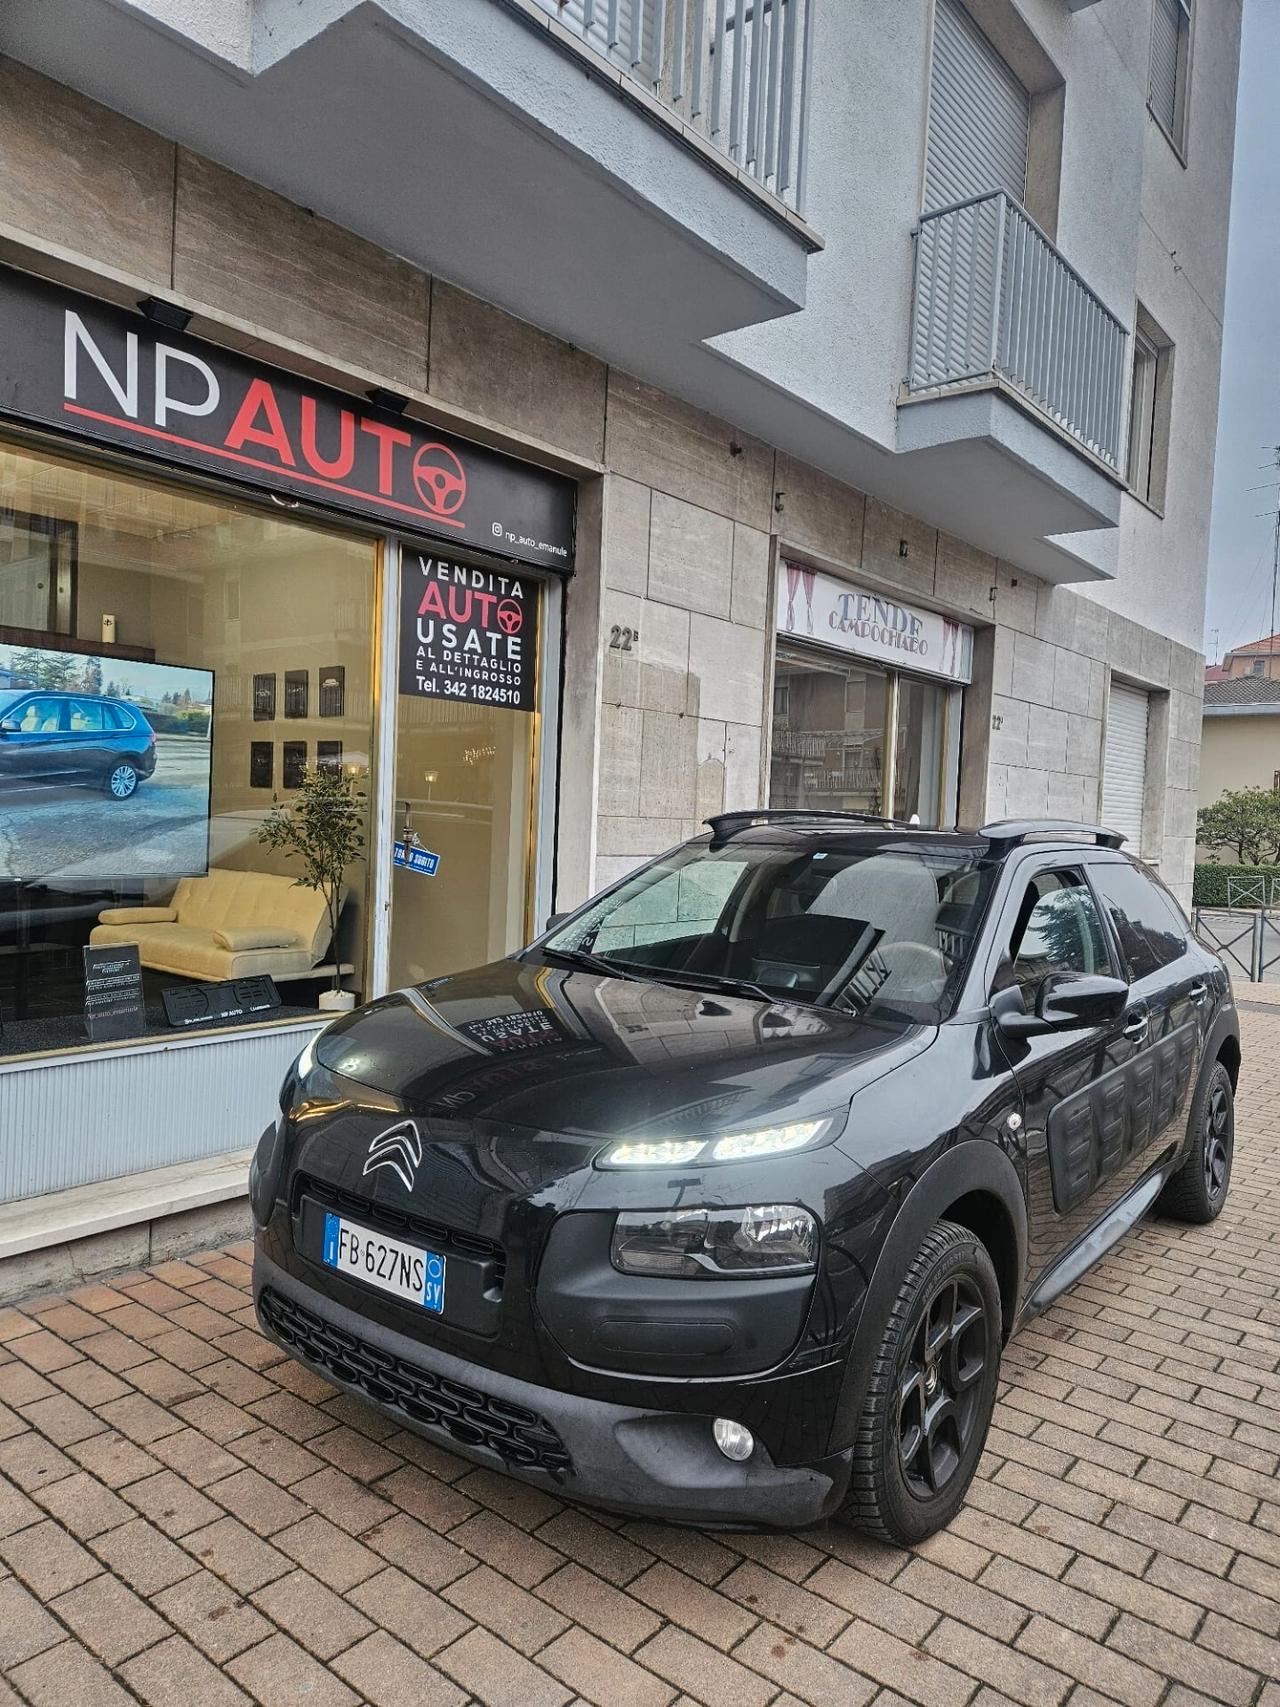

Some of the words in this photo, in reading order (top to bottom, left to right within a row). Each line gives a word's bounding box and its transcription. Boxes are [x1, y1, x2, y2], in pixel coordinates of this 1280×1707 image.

[418, 556, 524, 599] VENDITA
[418, 581, 523, 634] AUTO
[838, 593, 923, 636] TENDE
[416, 617, 522, 661] USATE
[416, 646, 436, 659] AL
[443, 650, 522, 673] DETTAGLIO
[416, 660, 423, 670] E
[430, 662, 521, 686] ALL'INGROSSO
[416, 676, 440, 693] Tel.
[444, 680, 467, 697] 342
[471, 684, 520, 704] 1824510
